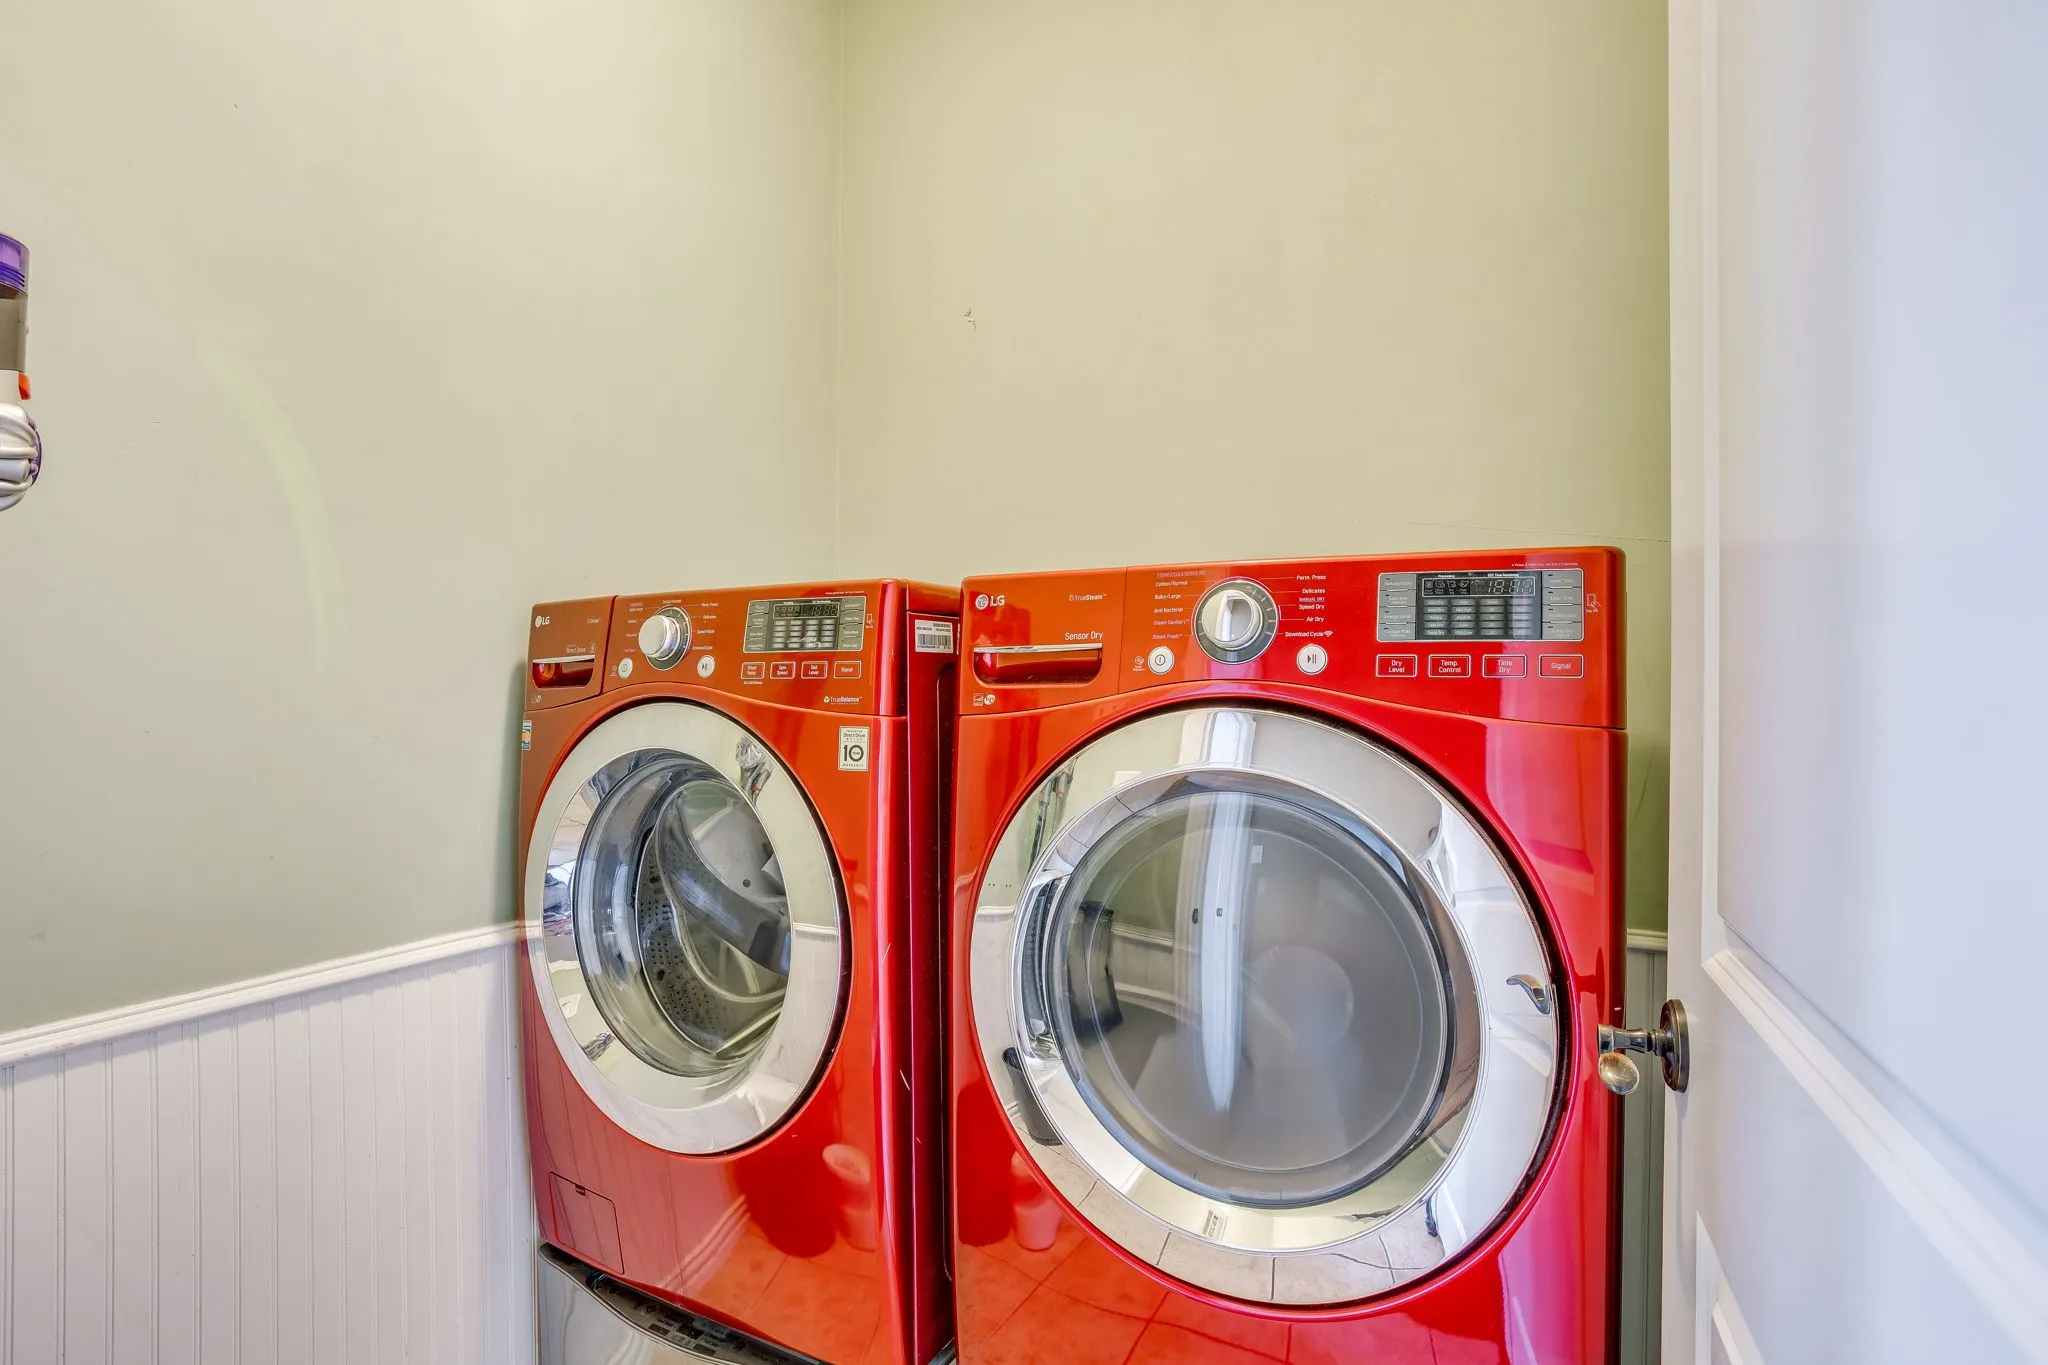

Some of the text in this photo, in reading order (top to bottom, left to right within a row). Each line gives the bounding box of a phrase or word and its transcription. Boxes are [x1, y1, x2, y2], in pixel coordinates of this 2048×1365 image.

[990, 595, 1005, 607] LG
[541, 616, 551, 625] LG
[1065, 631, 1104, 640] Sensor Dry
[1391, 659, 1403, 667] Dry
[1550, 662, 1572, 670] Signal
[843, 744, 864, 762] 10
